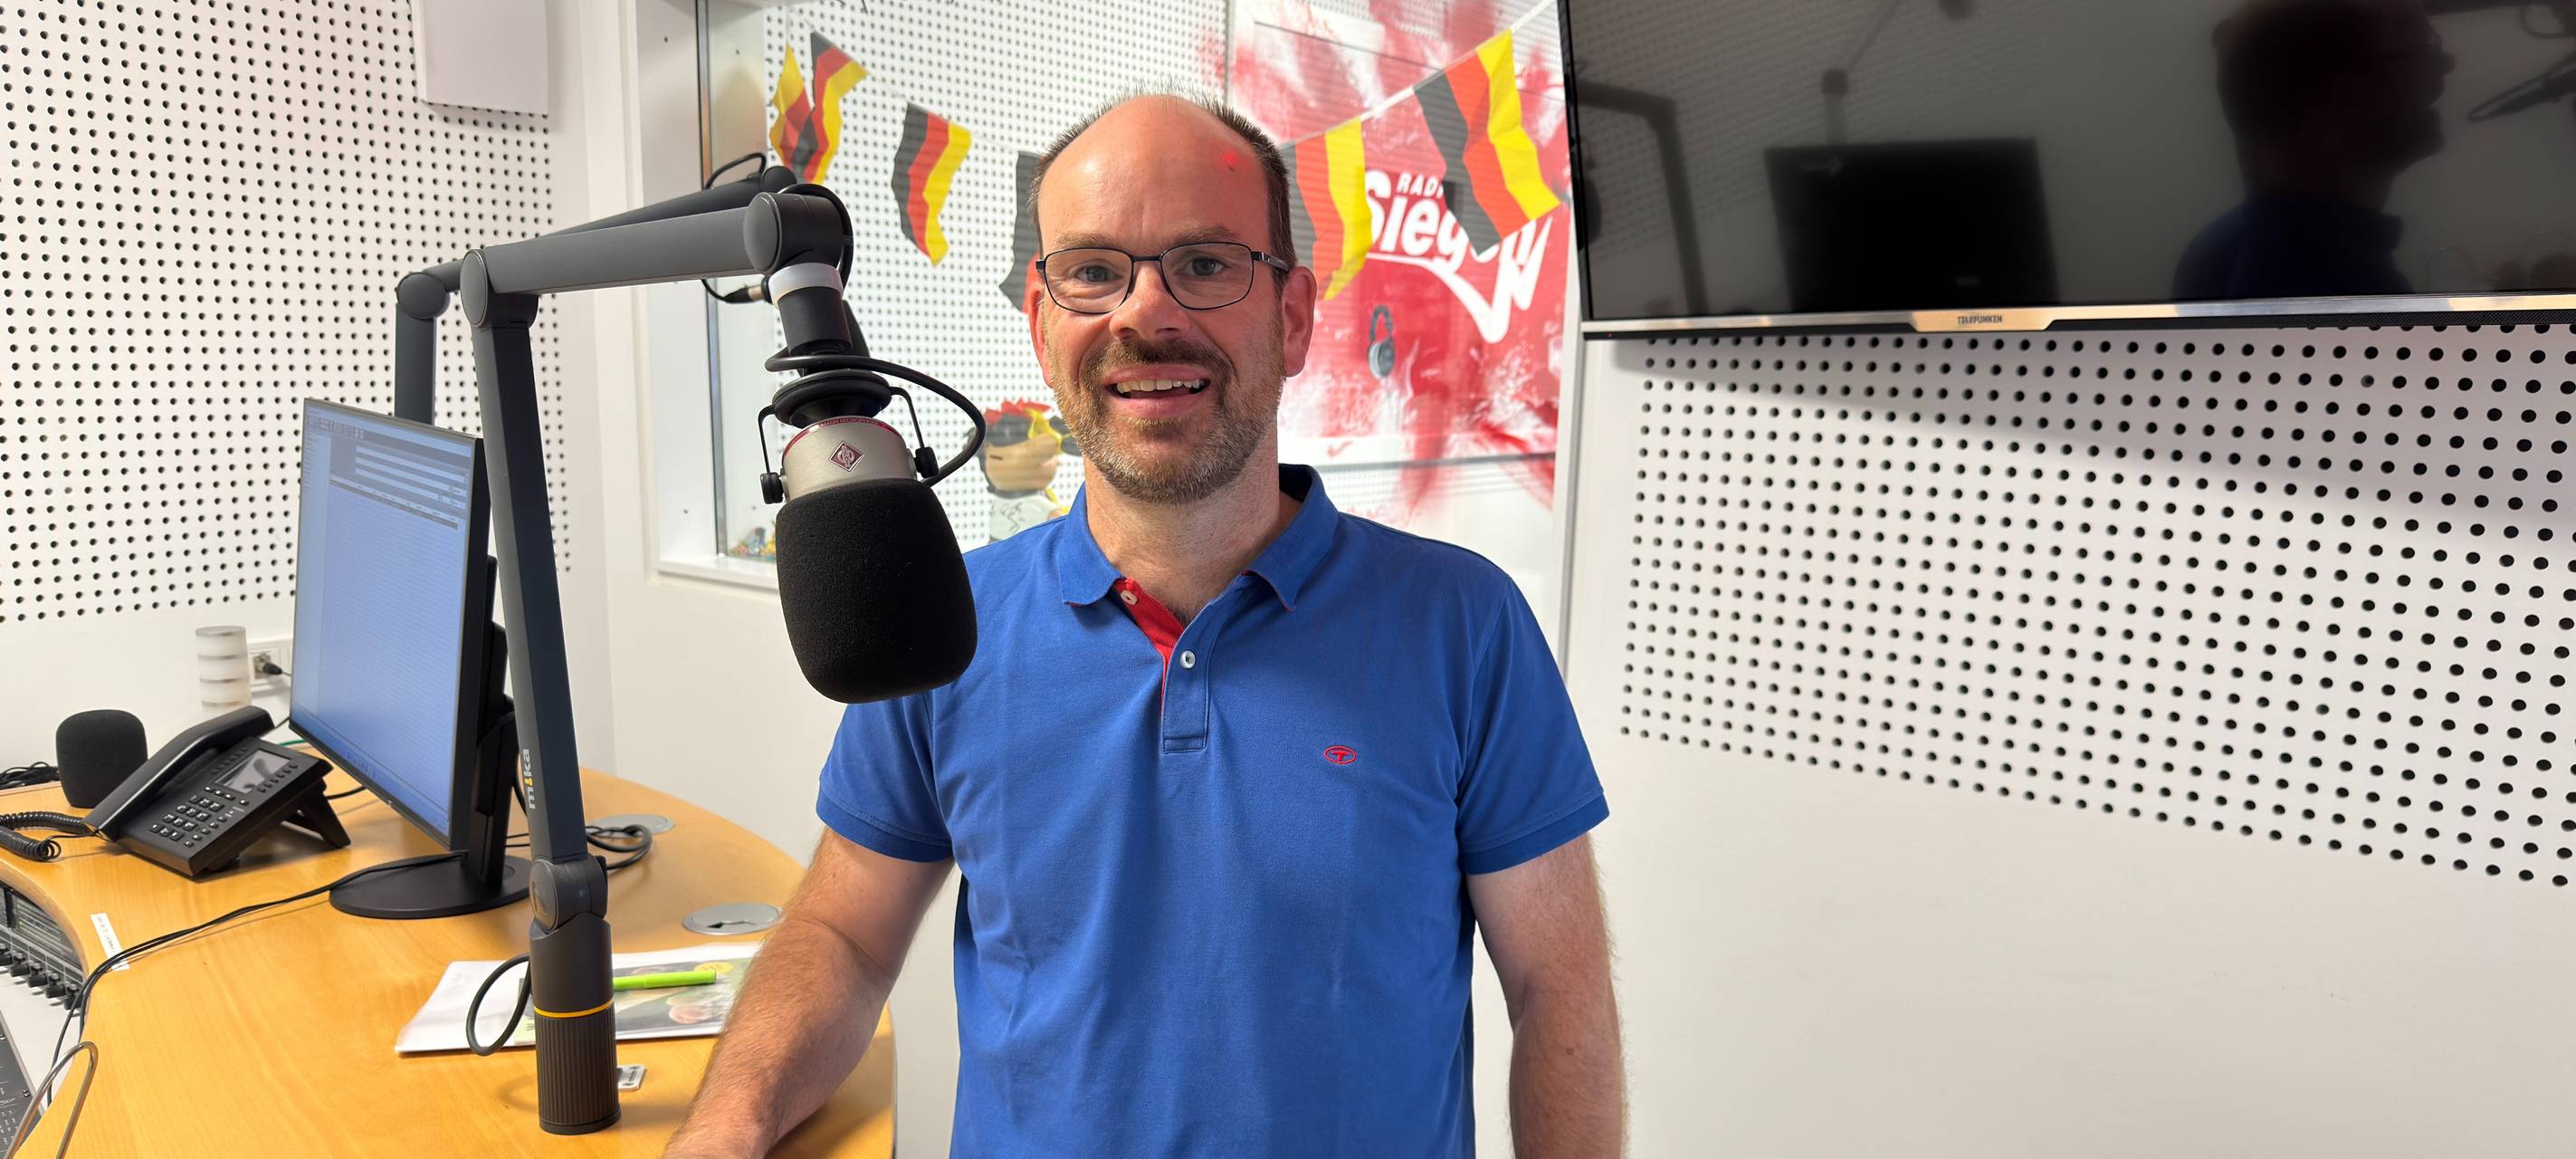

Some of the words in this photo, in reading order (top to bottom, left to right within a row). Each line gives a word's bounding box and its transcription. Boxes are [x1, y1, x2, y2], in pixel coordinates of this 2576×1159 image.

[1397, 172, 1444, 198] RADI
[1957, 315, 2003, 324] TELEFUNKEN
[523, 748, 536, 809] mika
